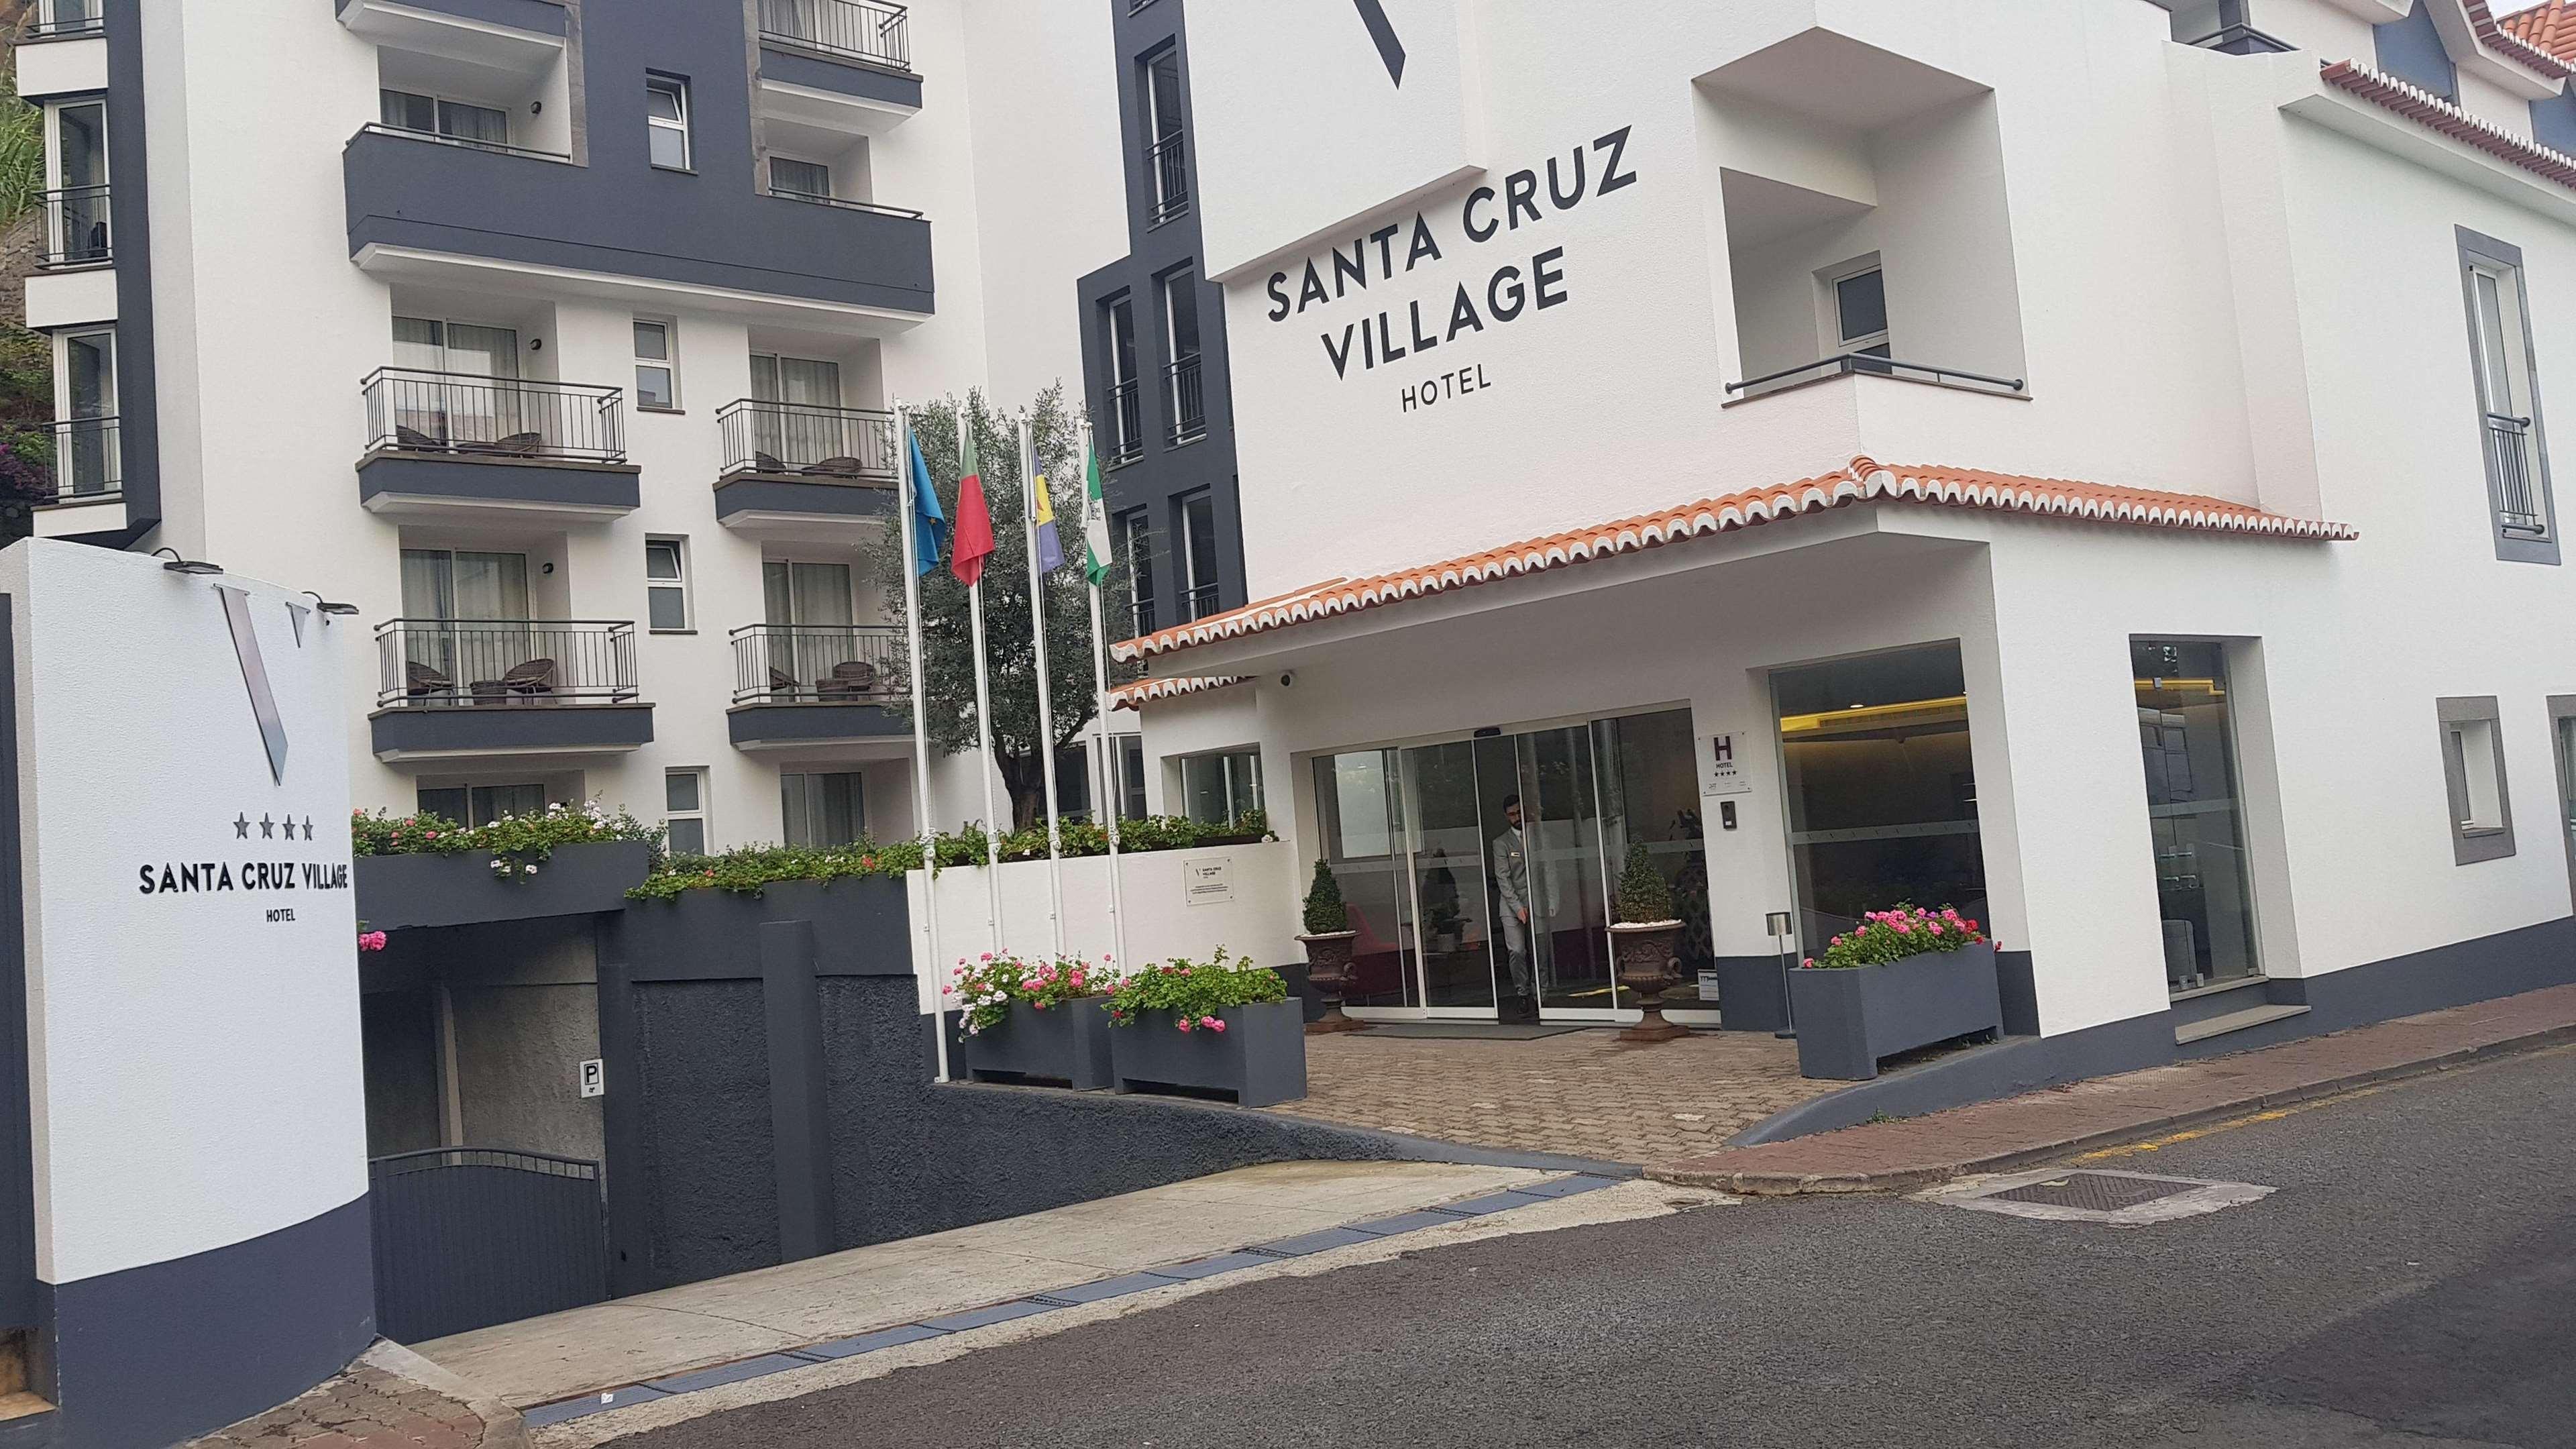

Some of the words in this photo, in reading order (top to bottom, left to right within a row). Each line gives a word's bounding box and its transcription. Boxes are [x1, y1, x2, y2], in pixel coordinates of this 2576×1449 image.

[1267, 210, 1442, 323] SANTA
[1462, 125, 1638, 244] CRUZ
[1320, 246, 1568, 381] VILLAGE
[1401, 364, 1491, 413] HOTEL
[1713, 736, 1732, 761] H
[139, 861, 234, 894] SANTA
[241, 862, 295, 890] CRUZ
[301, 862, 348, 890] VILLAGE
[266, 908, 296, 922] HOTEL
[586, 1065, 597, 1083] P
